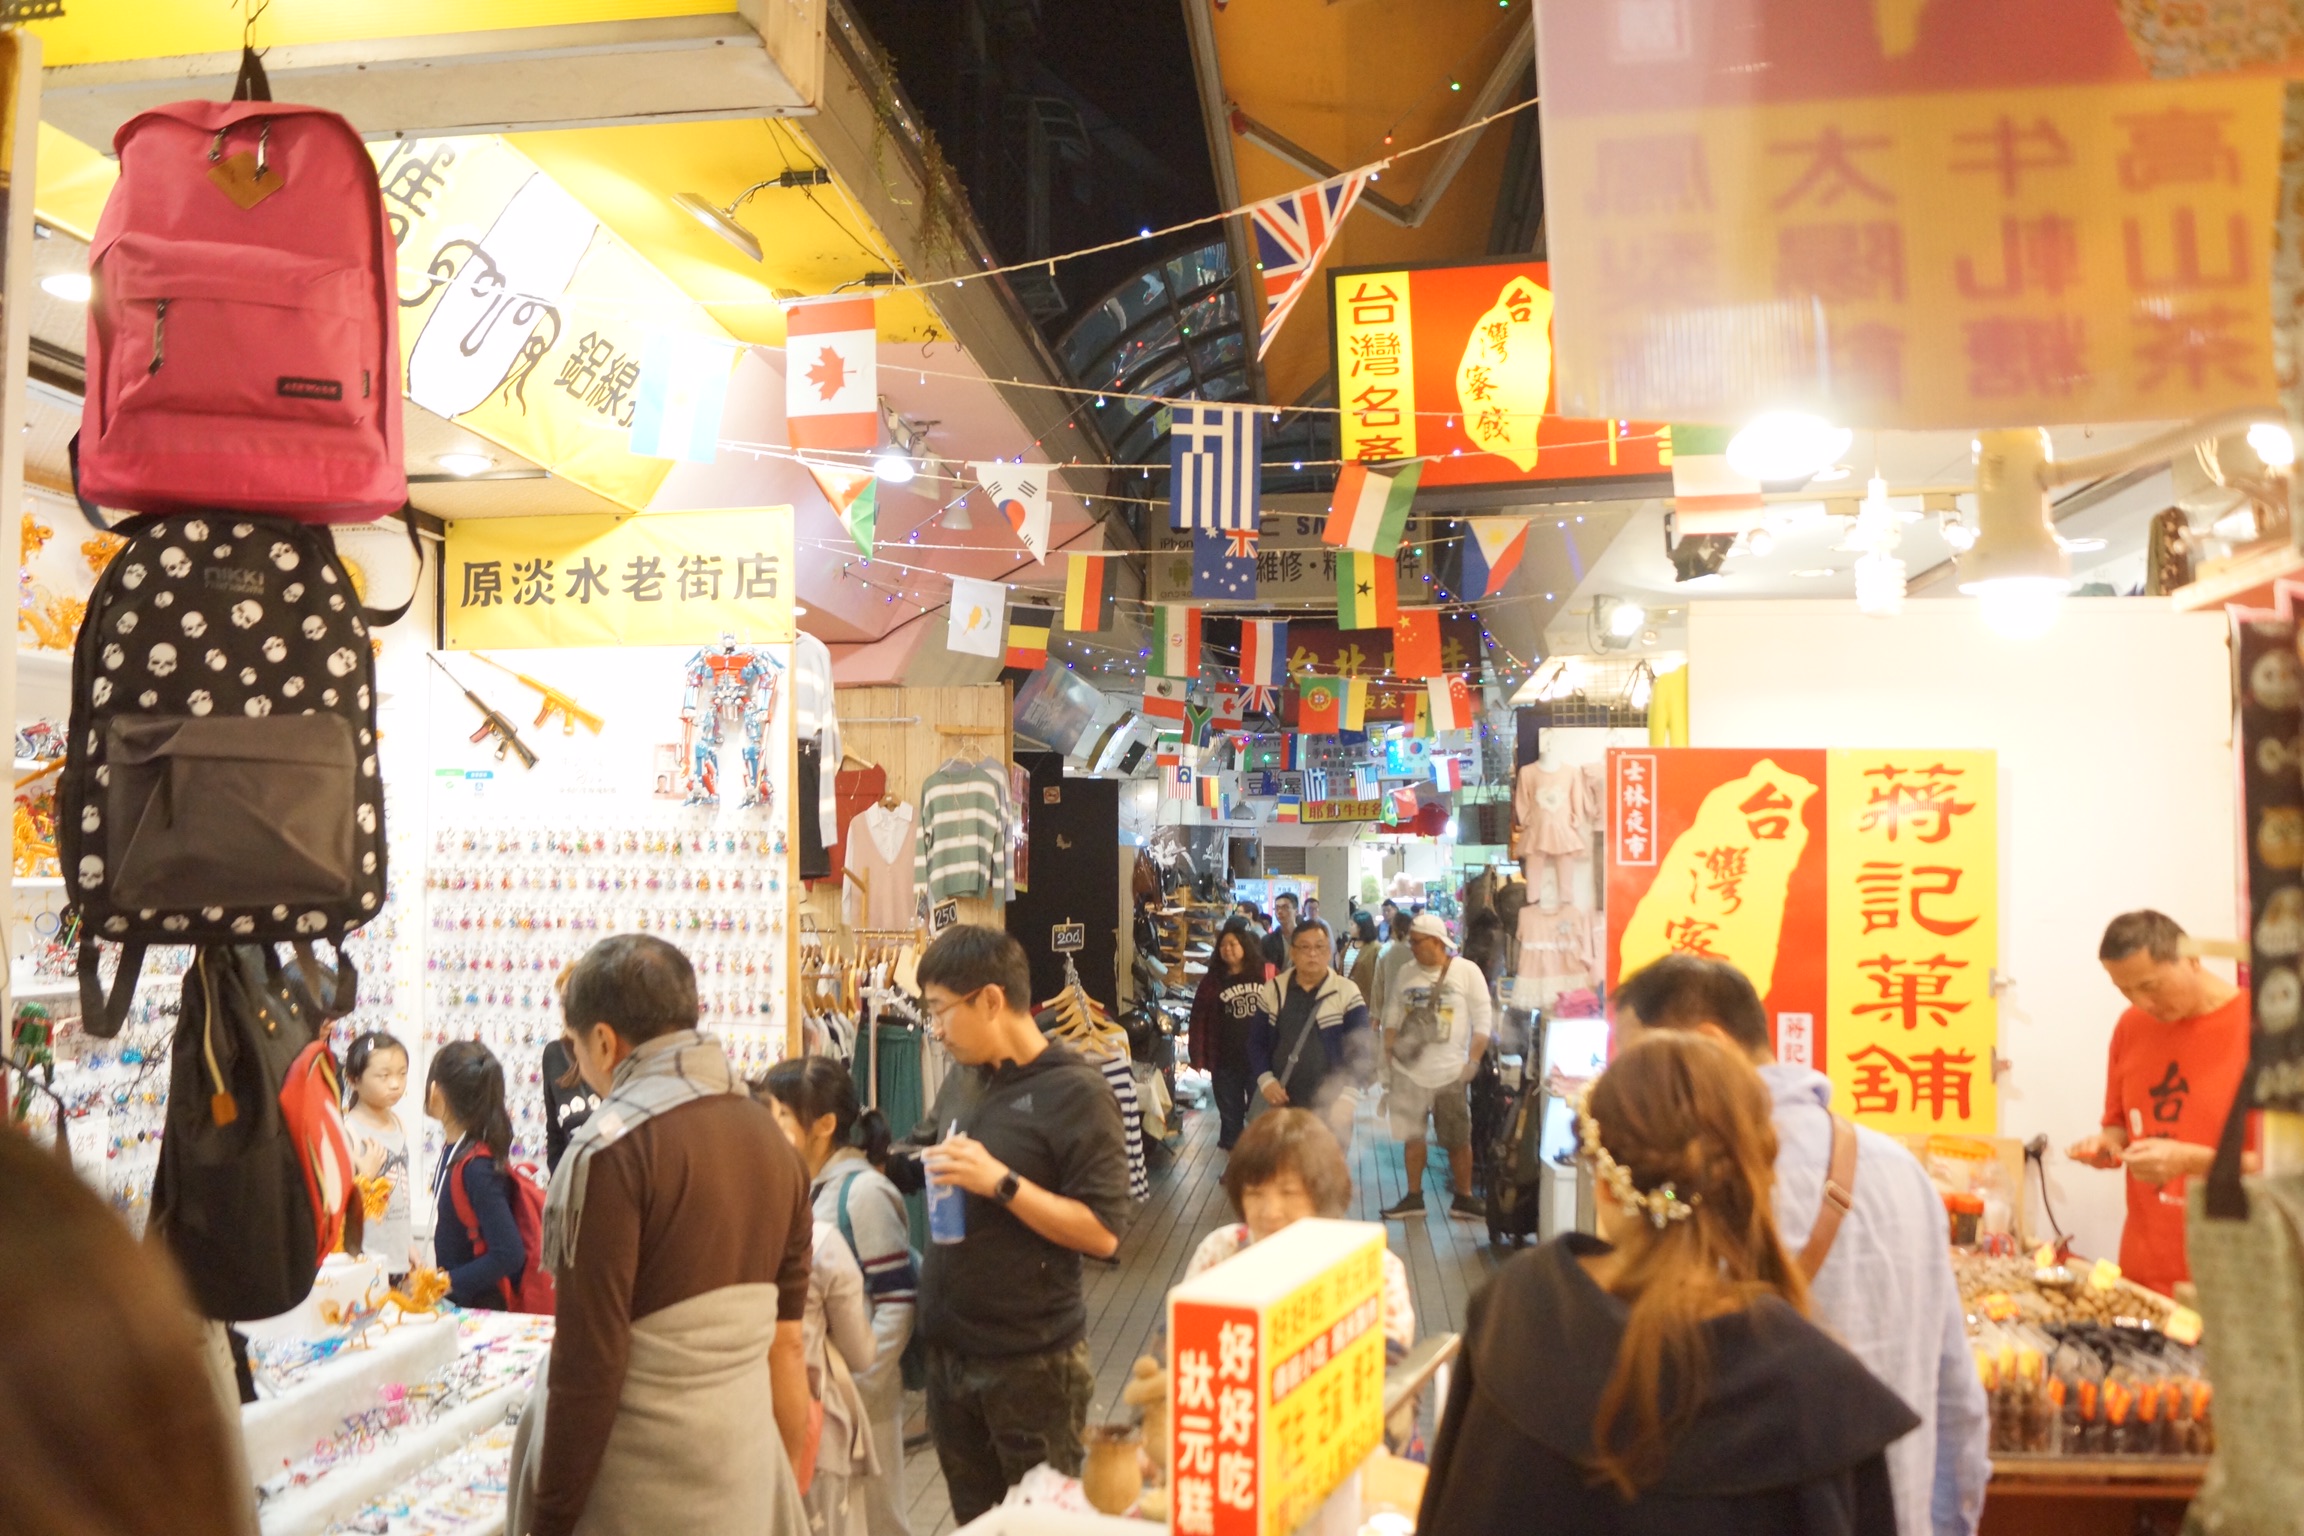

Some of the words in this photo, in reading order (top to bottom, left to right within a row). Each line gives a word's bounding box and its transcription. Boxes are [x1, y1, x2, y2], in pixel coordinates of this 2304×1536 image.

[1465, 288, 1532, 443] 台灣蜜餞
[459, 551, 780, 608] 原淡水老街店
[1160, 538, 1194, 549] iPhon
[1622, 759, 1651, 860] 士林夜市
[1664, 782, 1796, 960] 台灣蜜
[935, 905, 957, 928] 250
[1846, 762, 1982, 1122] 蔣記菓舖
[1217, 1320, 1256, 1512] 好好吃
